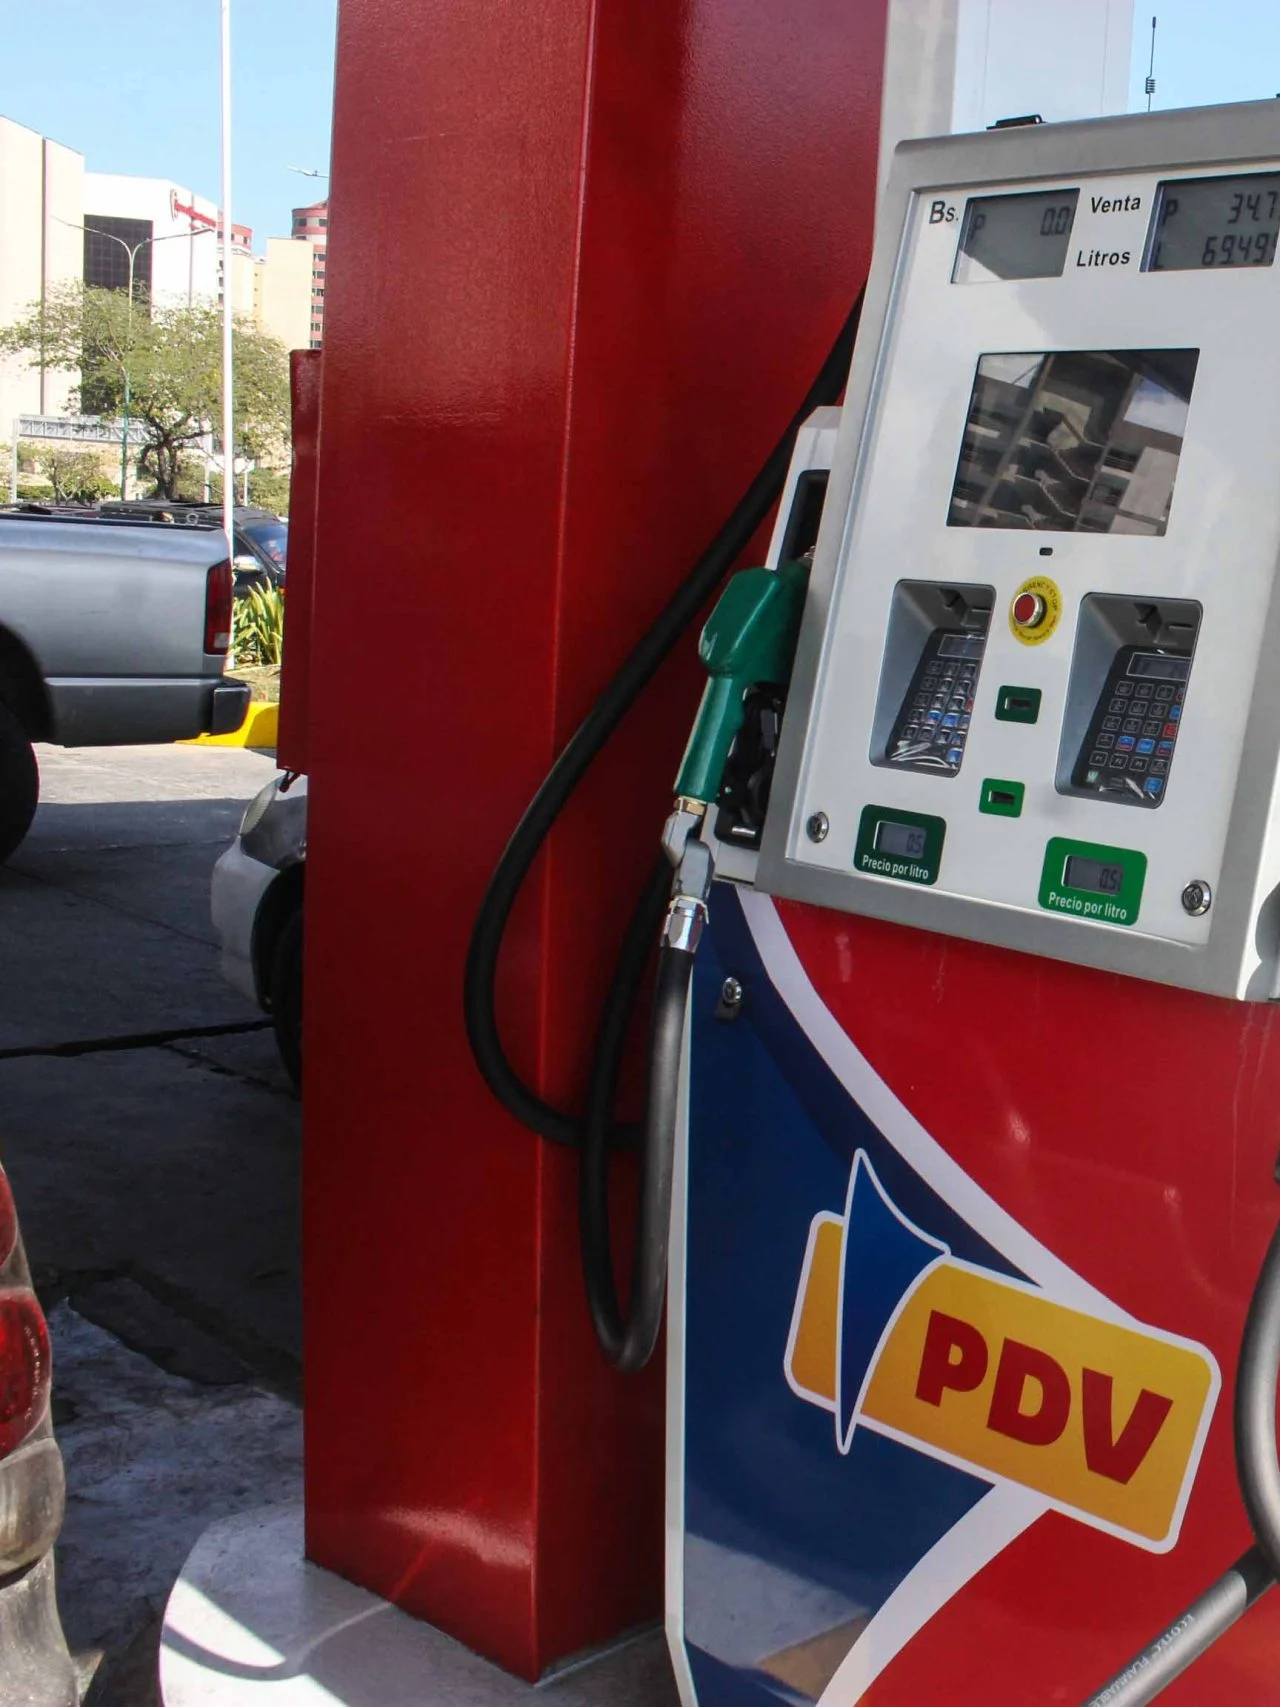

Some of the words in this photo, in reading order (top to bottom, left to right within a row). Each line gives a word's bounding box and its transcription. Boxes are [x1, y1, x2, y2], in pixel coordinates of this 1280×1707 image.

[929, 200, 959, 224] Bs.
[1091, 195, 1141, 213] Venta
[1076, 250, 1131, 267] Litros
[862, 854, 891, 872] Precio
[892, 863, 908, 876] por
[909, 864, 929, 879] litro
[1048, 891, 1082, 911] Precio
[1083, 901, 1103, 915] por
[1104, 902, 1127, 920] litro
[915, 1309, 1173, 1485] PDV
